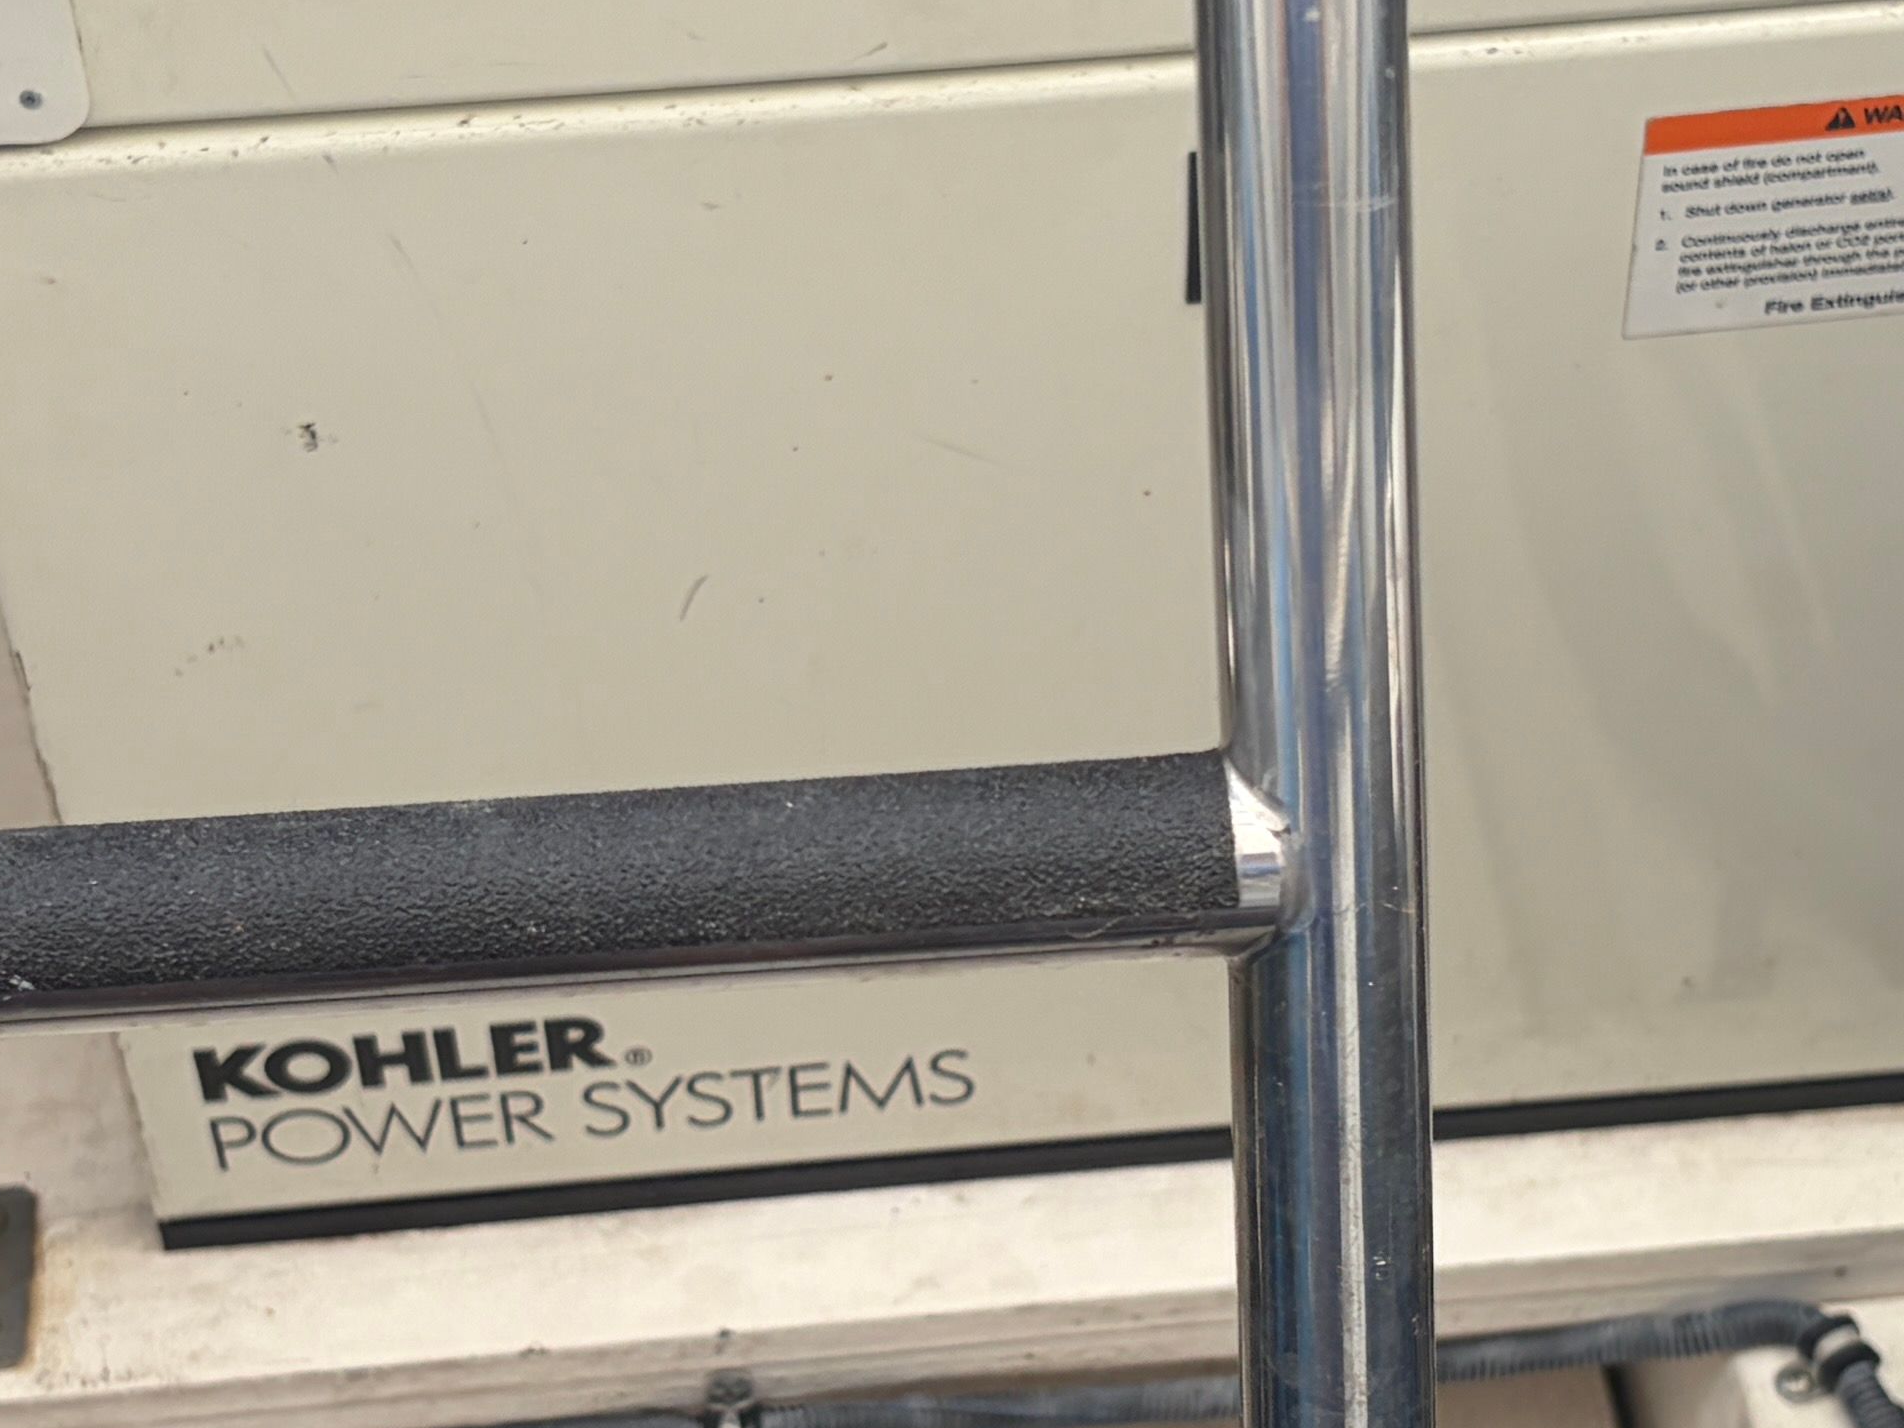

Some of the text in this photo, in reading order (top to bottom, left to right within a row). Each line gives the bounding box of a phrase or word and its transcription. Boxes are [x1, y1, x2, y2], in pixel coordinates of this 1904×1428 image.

[1680, 163, 1718, 175] case
[1722, 159, 1739, 172] of
[1770, 154, 1792, 167] do
[1797, 152, 1822, 165] not
[1825, 148, 1864, 164] open
[1661, 177, 1709, 193] sound
[1713, 172, 1760, 188] shield
[1684, 203, 1721, 219] Shut
[1724, 199, 1767, 214] down
[1770, 193, 1846, 213] generator
[1680, 227, 1781, 251] Continuously
[1784, 220, 1860, 240] discharge
[1679, 246, 1747, 263] contents
[1750, 244, 1768, 256] of
[1768, 240, 1811, 255] halon
[1705, 255, 1799, 278] extinguisher
[1801, 249, 1861, 267] through
[1763, 297, 1805, 316] Fire
[193, 1017, 617, 1105] KOHLER
[208, 1048, 976, 1171] POWER SYSTEMS
